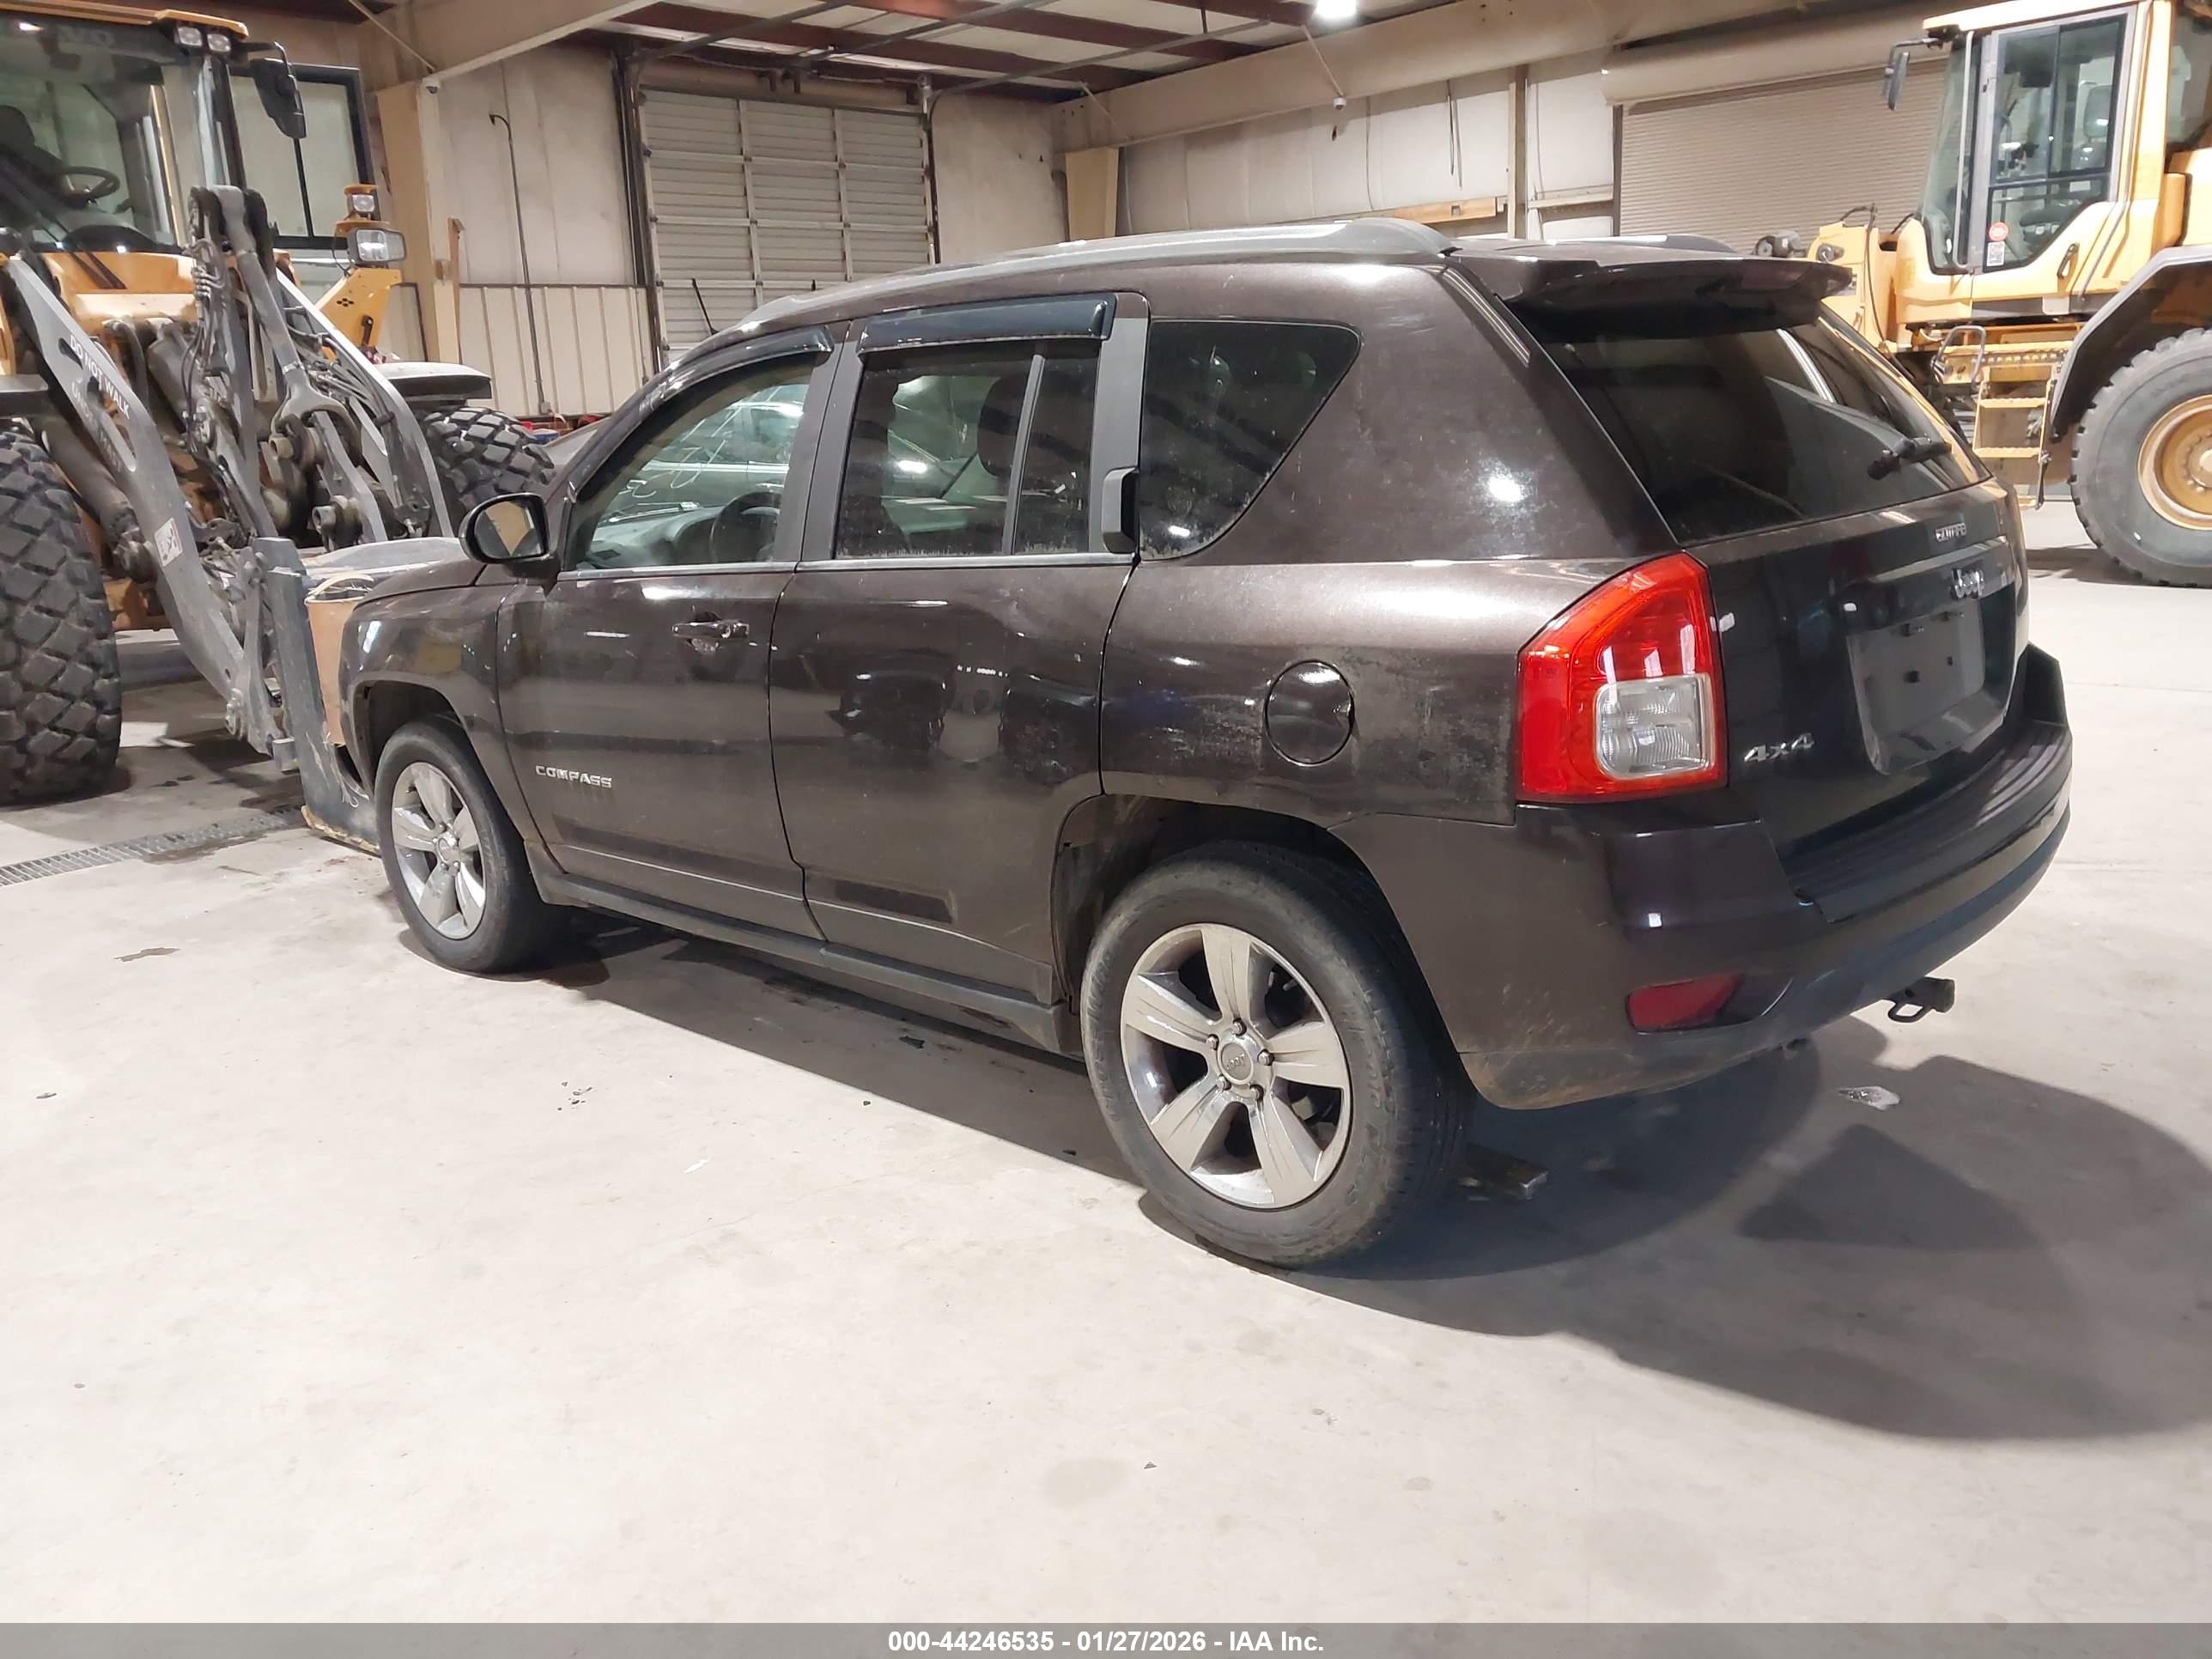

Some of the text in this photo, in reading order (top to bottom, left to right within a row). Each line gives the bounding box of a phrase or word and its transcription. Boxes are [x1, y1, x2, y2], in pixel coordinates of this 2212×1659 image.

[70, 334, 131, 421] DO NOT WALK
[1744, 732, 1814, 763] 4x4
[535, 765, 612, 788] COMPASS
